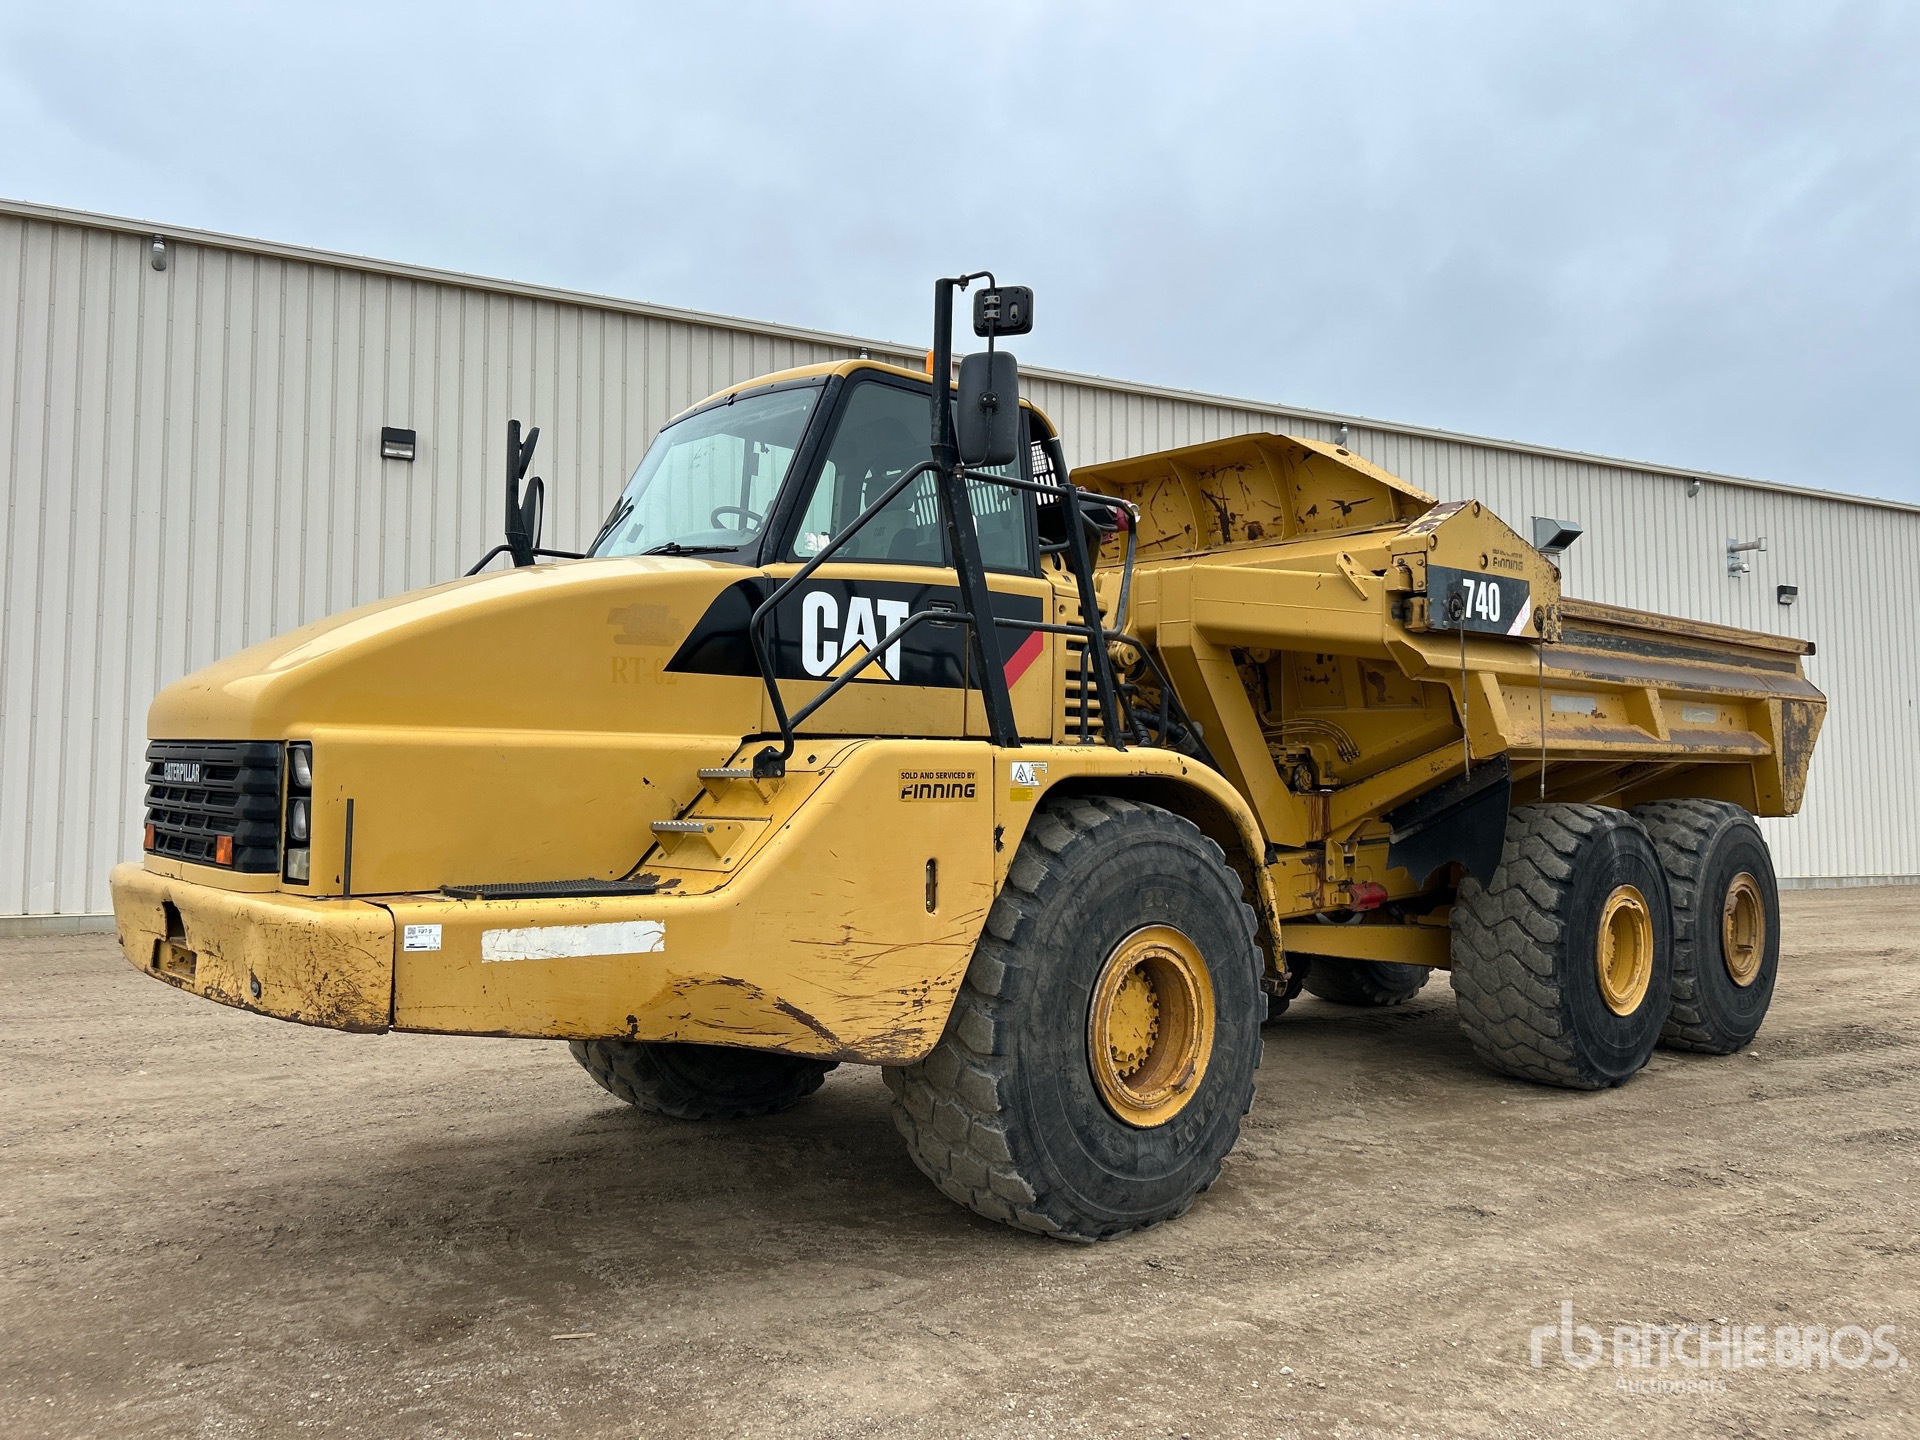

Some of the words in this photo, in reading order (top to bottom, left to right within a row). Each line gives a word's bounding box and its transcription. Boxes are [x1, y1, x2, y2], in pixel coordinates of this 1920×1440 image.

[1463, 578, 1500, 622] 740
[802, 591, 909, 681] CAT
[164, 762, 200, 783] CATERPILLAR
[901, 772, 918, 780] SOLD
[920, 772, 934, 780] AND
[901, 783, 976, 799] FINNING
